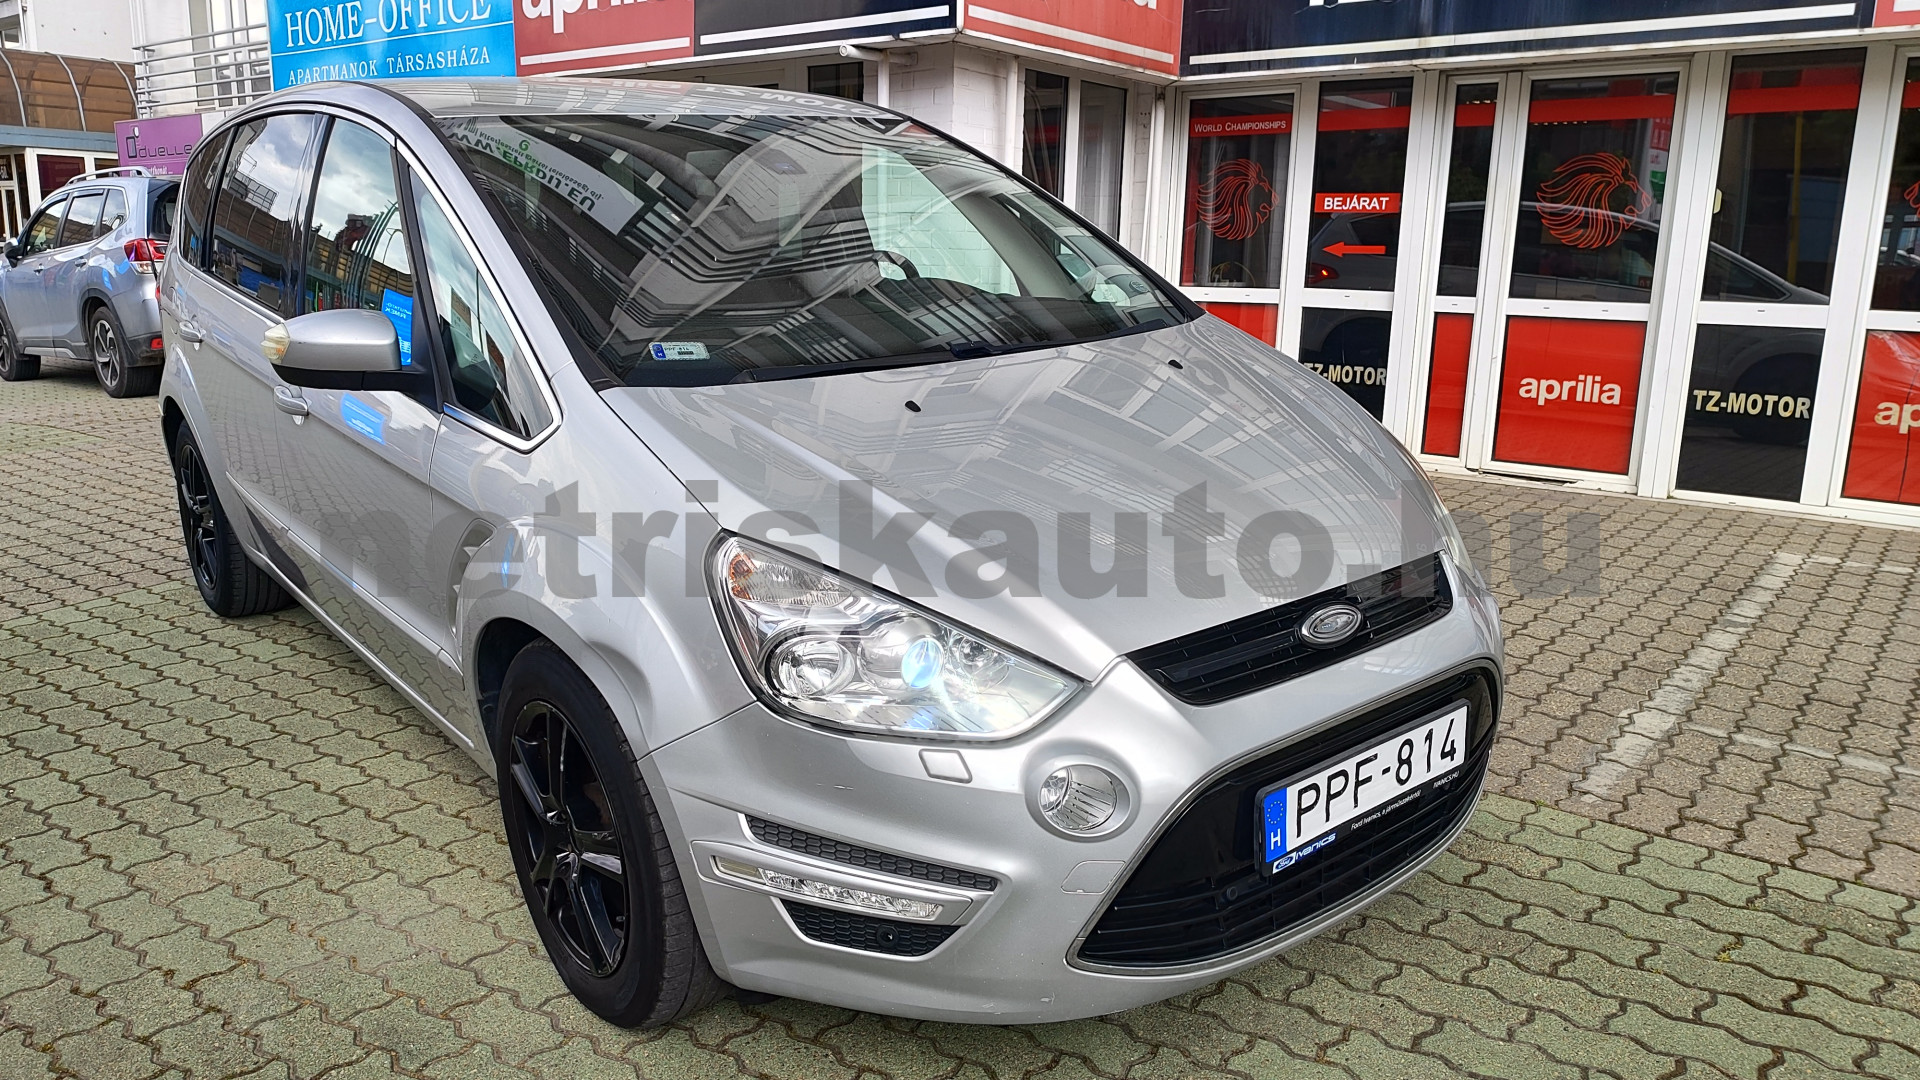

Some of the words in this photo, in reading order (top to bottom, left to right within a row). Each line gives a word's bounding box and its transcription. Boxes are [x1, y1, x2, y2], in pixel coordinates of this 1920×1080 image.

[284, 0, 492, 48] HOME-OFFICE
[288, 59, 378, 86] APARTMANOK
[387, 45, 491, 74] TÁRSASHÁZA
[1323, 194, 1390, 211] BEJÁRAT
[1518, 374, 1622, 406] aprilia
[1693, 389, 1811, 420] TZ-MOTOR
[1296, 717, 1457, 839] PPF-814
[1270, 828, 1281, 851] H
